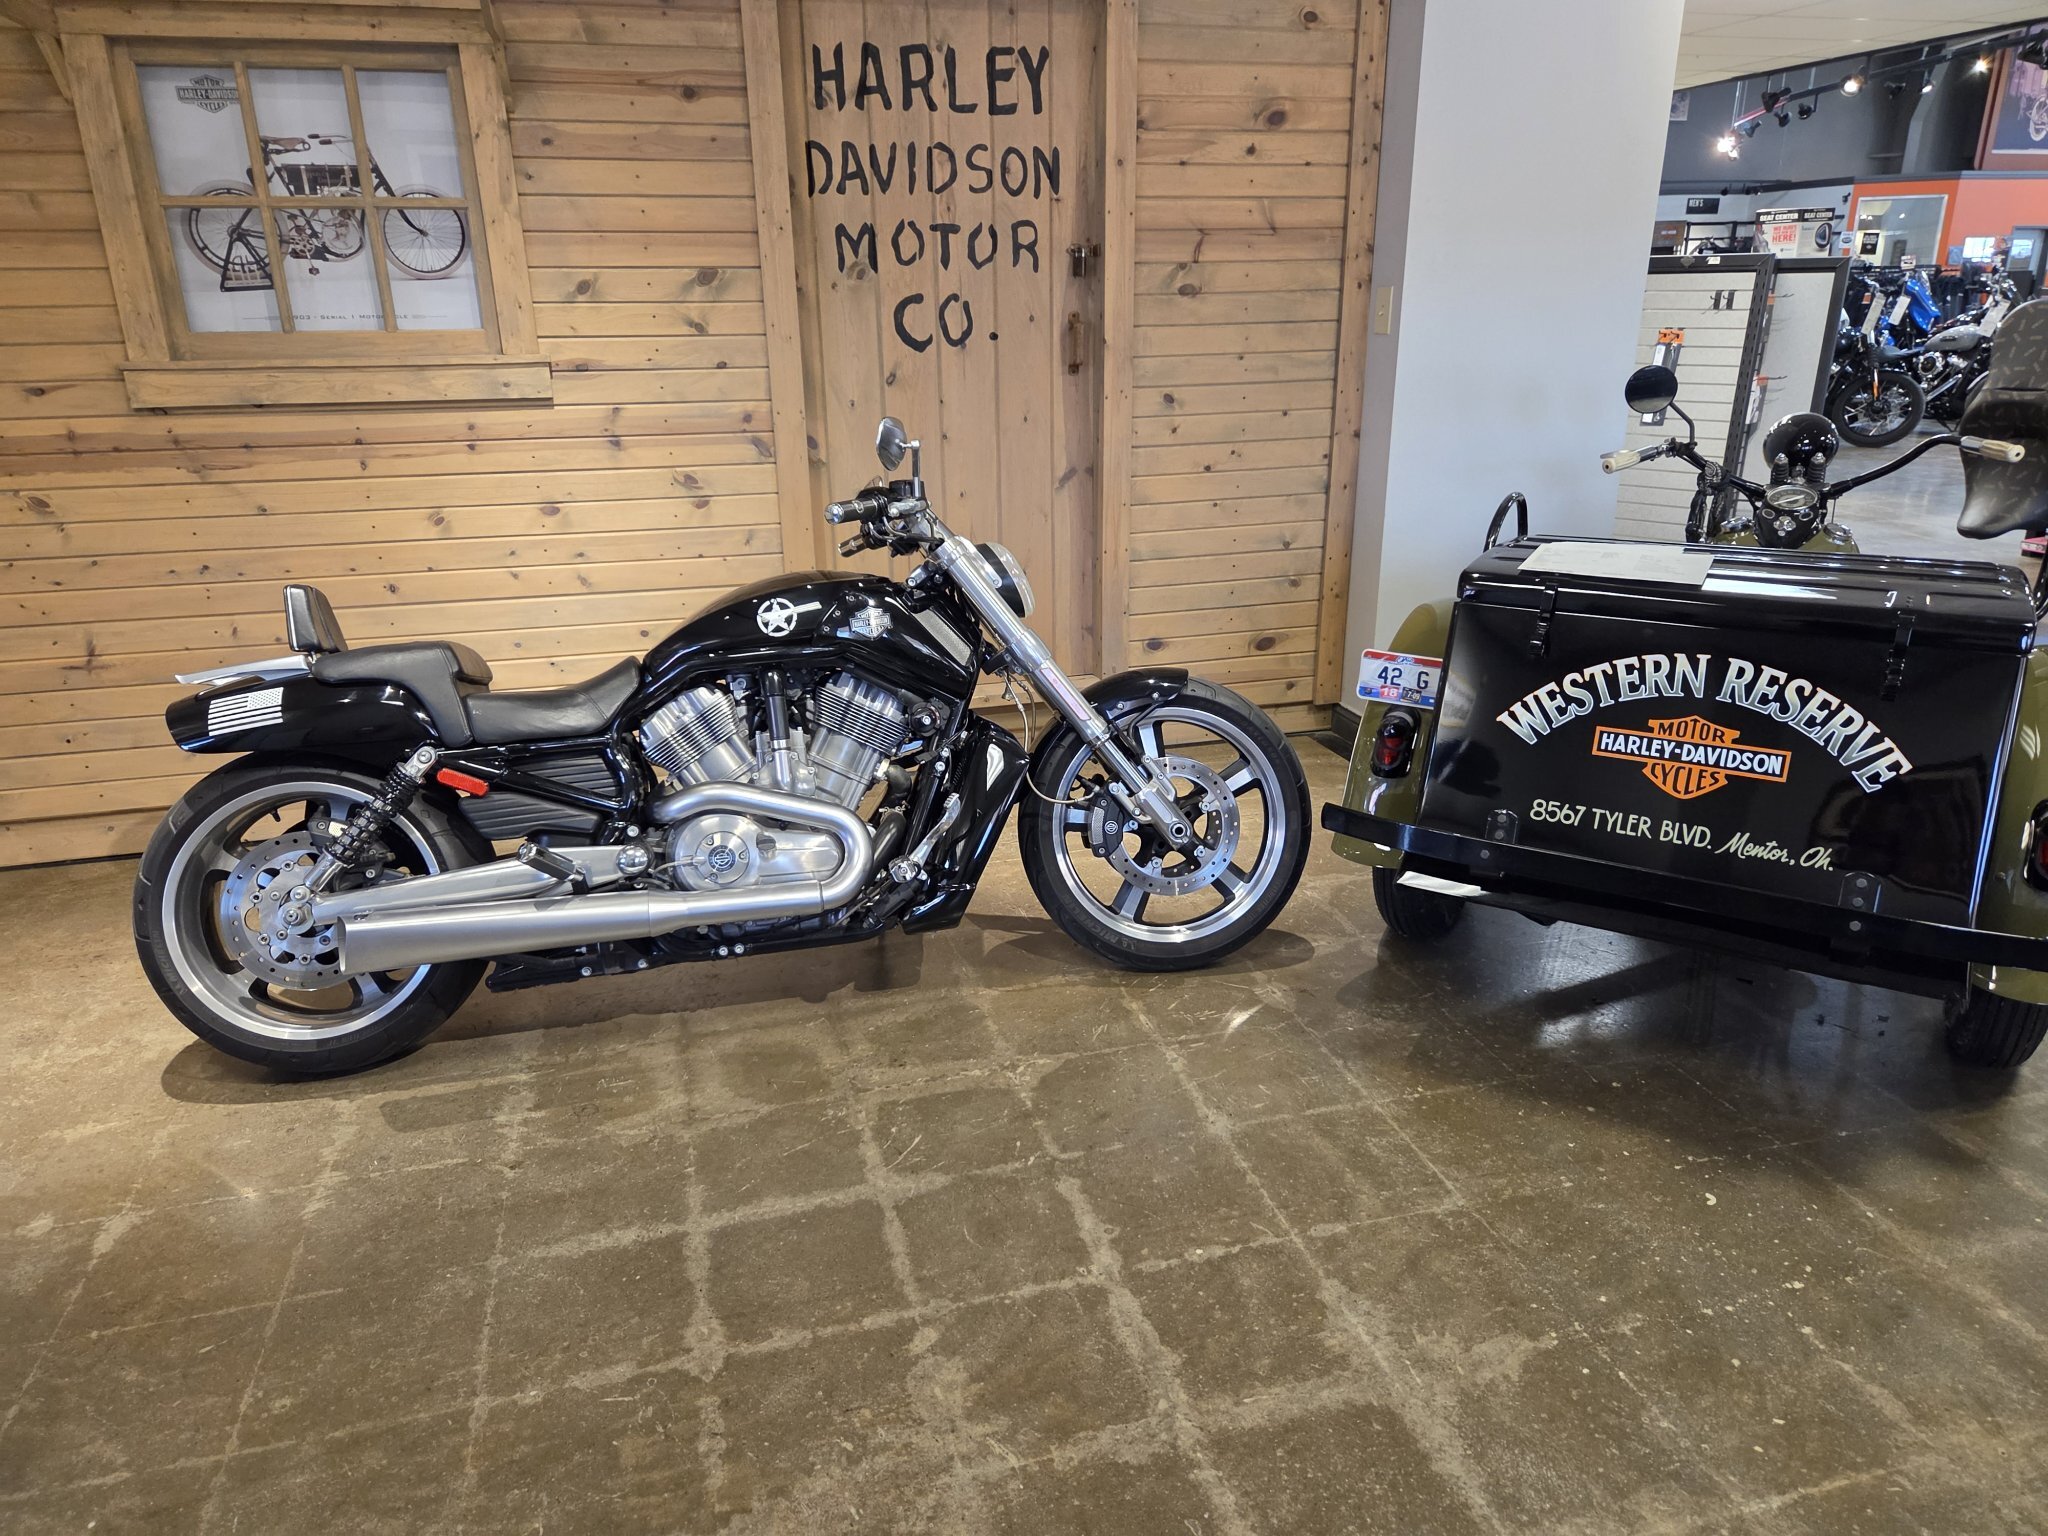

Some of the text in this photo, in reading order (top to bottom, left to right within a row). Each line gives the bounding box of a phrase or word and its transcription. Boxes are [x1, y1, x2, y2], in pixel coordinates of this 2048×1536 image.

[812, 41, 1049, 116] HARLEY
[805, 139, 1060, 200] DAVIDSON
[1759, 214, 1774, 222] SEAT
[1772, 234, 1796, 243] HERE!
[834, 218, 1039, 274] MOTOR
[893, 292, 999, 353] CO.
[1377, 666, 1429, 690] 42 G
[1382, 687, 1399, 697] 18
[1495, 653, 1914, 794] WESTERN RESERVE
[1658, 718, 1726, 743] MOTOR
[1600, 733, 1783, 775] HARLEY-DAVIDSON
[1651, 762, 1721, 796] CYCLES
[1530, 799, 1834, 872] 8567 TYLER BLVD. Mentor, Oh.
